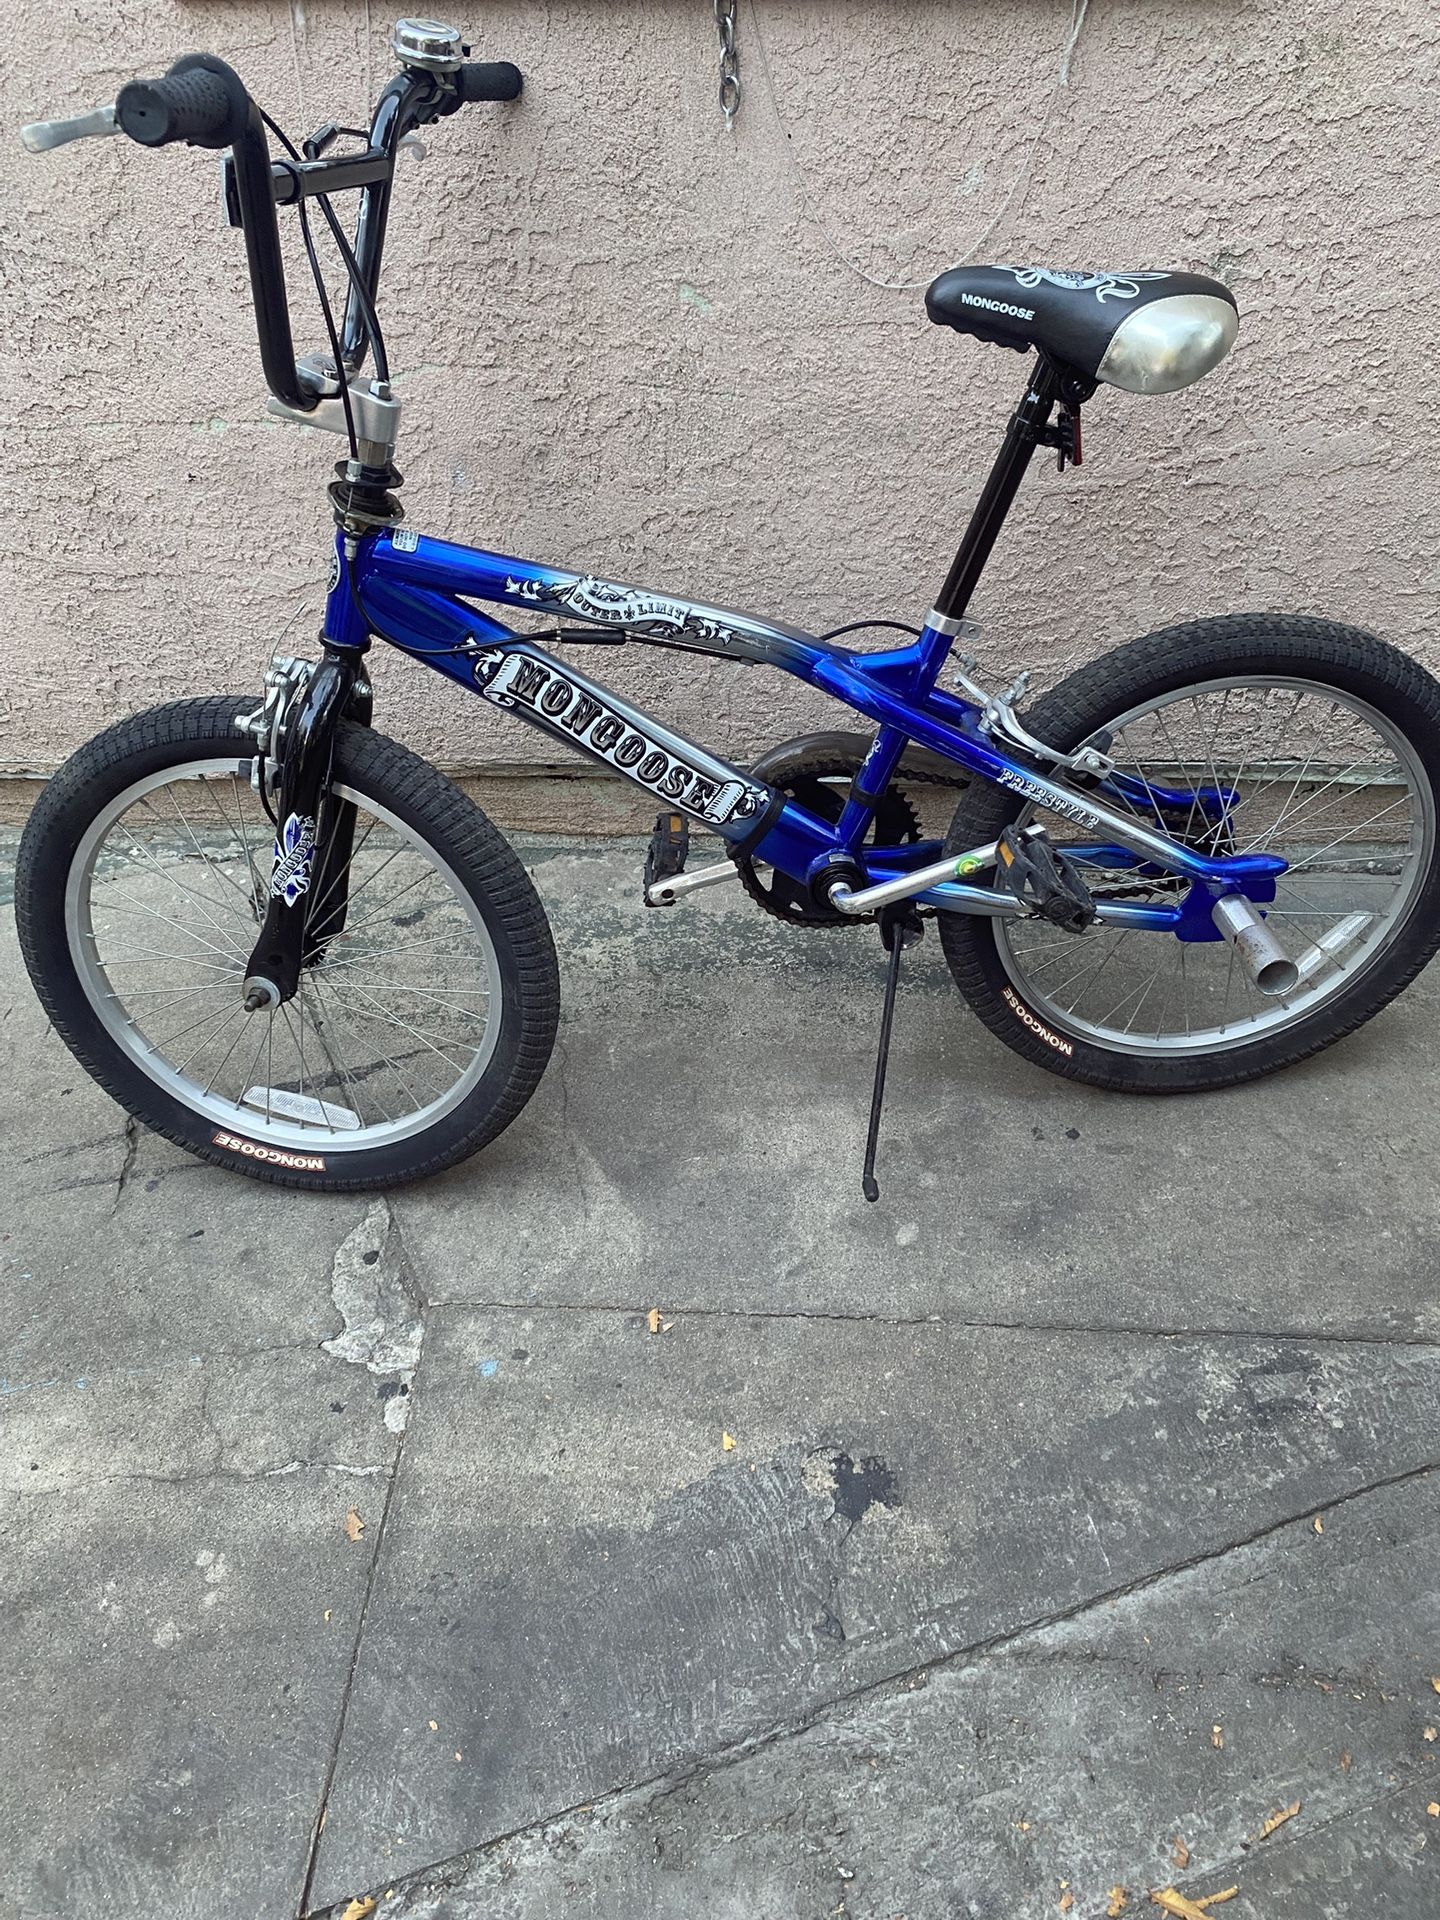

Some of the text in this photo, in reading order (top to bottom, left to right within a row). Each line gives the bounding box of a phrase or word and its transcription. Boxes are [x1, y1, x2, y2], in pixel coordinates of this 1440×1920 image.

[961, 293, 1036, 321] MONGOOSE
[573, 592, 685, 621] OUTER LIMIT
[506, 656, 720, 812] MONGOOSE
[997, 767, 1099, 830] FREESTYLE
[1003, 987, 1073, 1056] MONGOOSE
[215, 1133, 325, 1170] MONGOOSE
